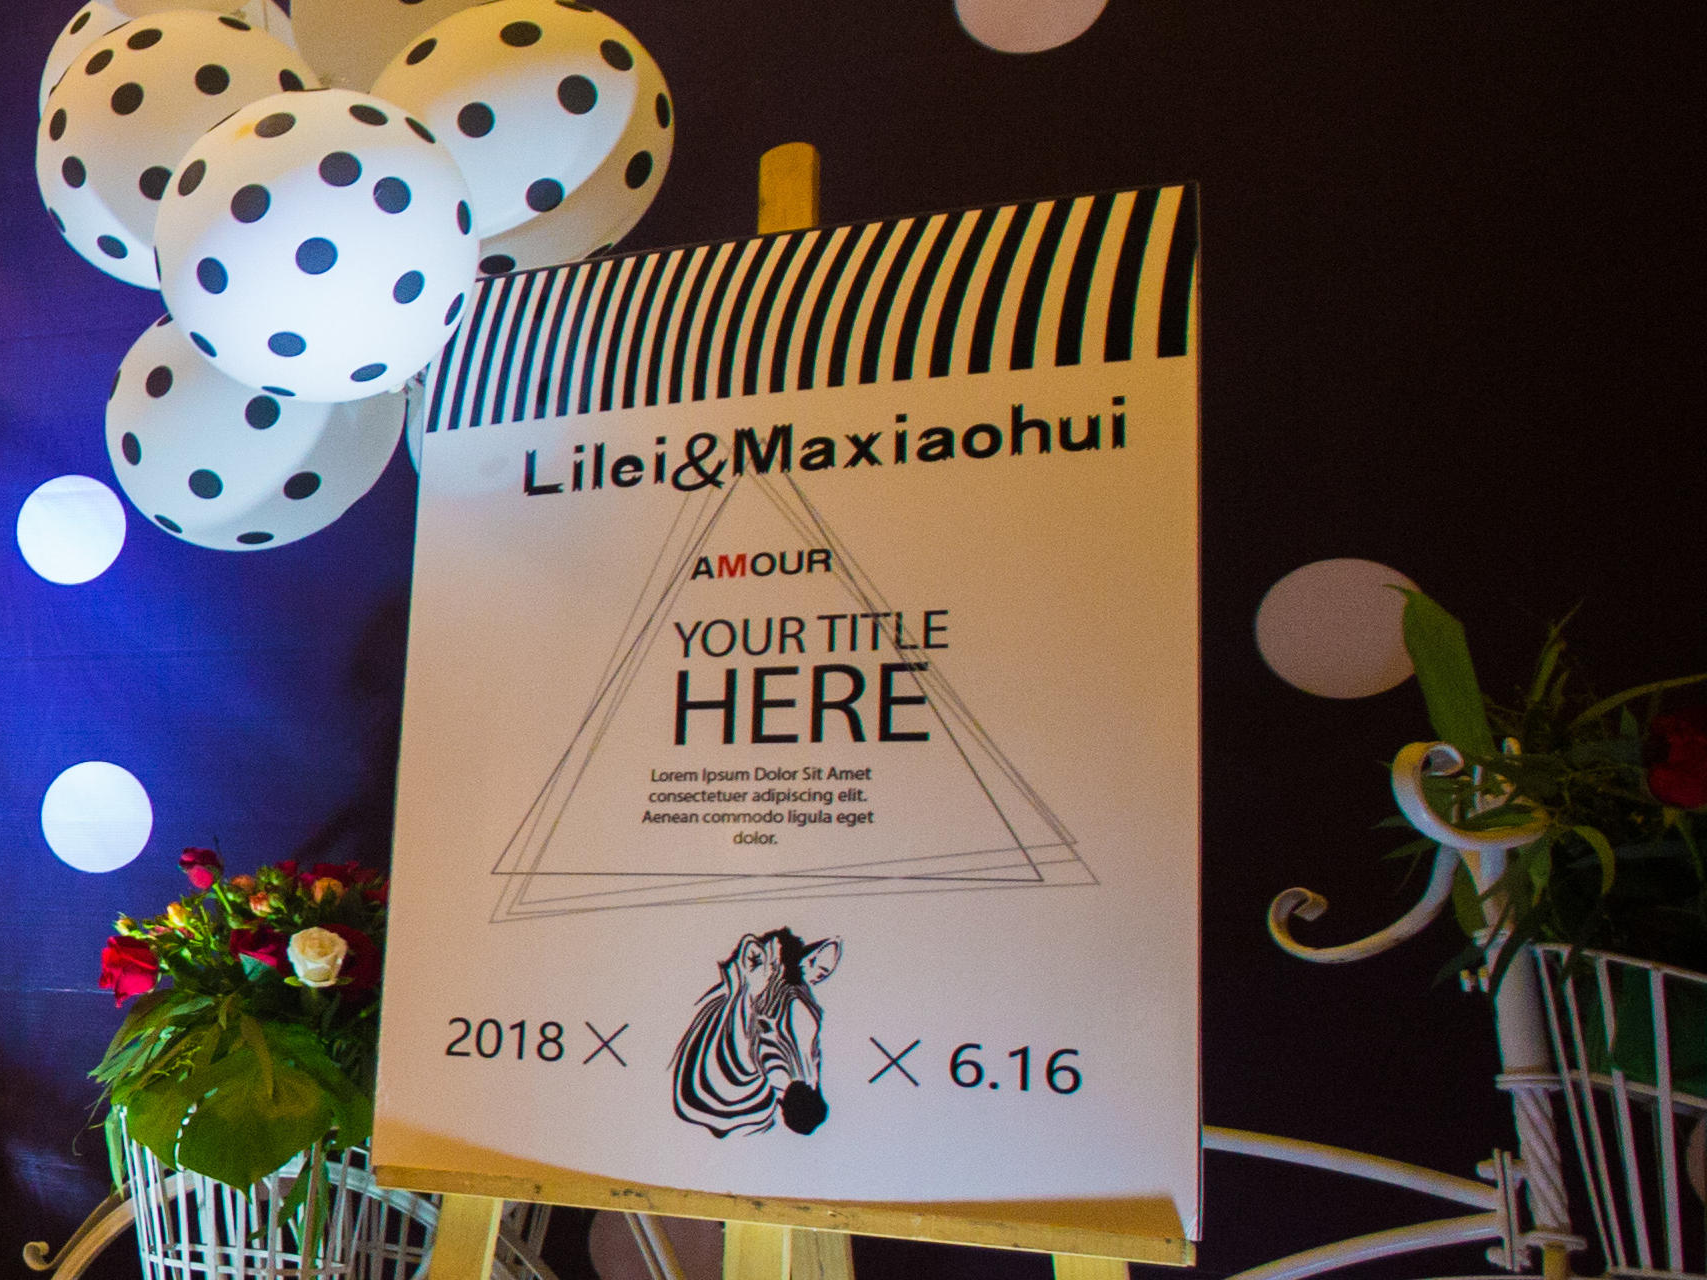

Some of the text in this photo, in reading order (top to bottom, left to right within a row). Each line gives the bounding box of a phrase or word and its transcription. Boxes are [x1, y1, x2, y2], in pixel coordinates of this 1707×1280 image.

[523, 395, 1127, 497] Lilei&Maxiaohui
[690, 548, 834, 581] AMOUR
[673, 610, 950, 658] YOUR TITLE
[673, 662, 931, 746] HERE
[650, 766, 872, 785] Lorem Ipsum Dolor Sit Amet
[648, 788, 868, 806] consectetuer adipiscing elit.
[641, 810, 875, 827] Aenean commodo ligula eget
[732, 831, 779, 845] dolor.
[445, 1017, 565, 1062] 2018
[948, 1042, 1084, 1095] 6.16
